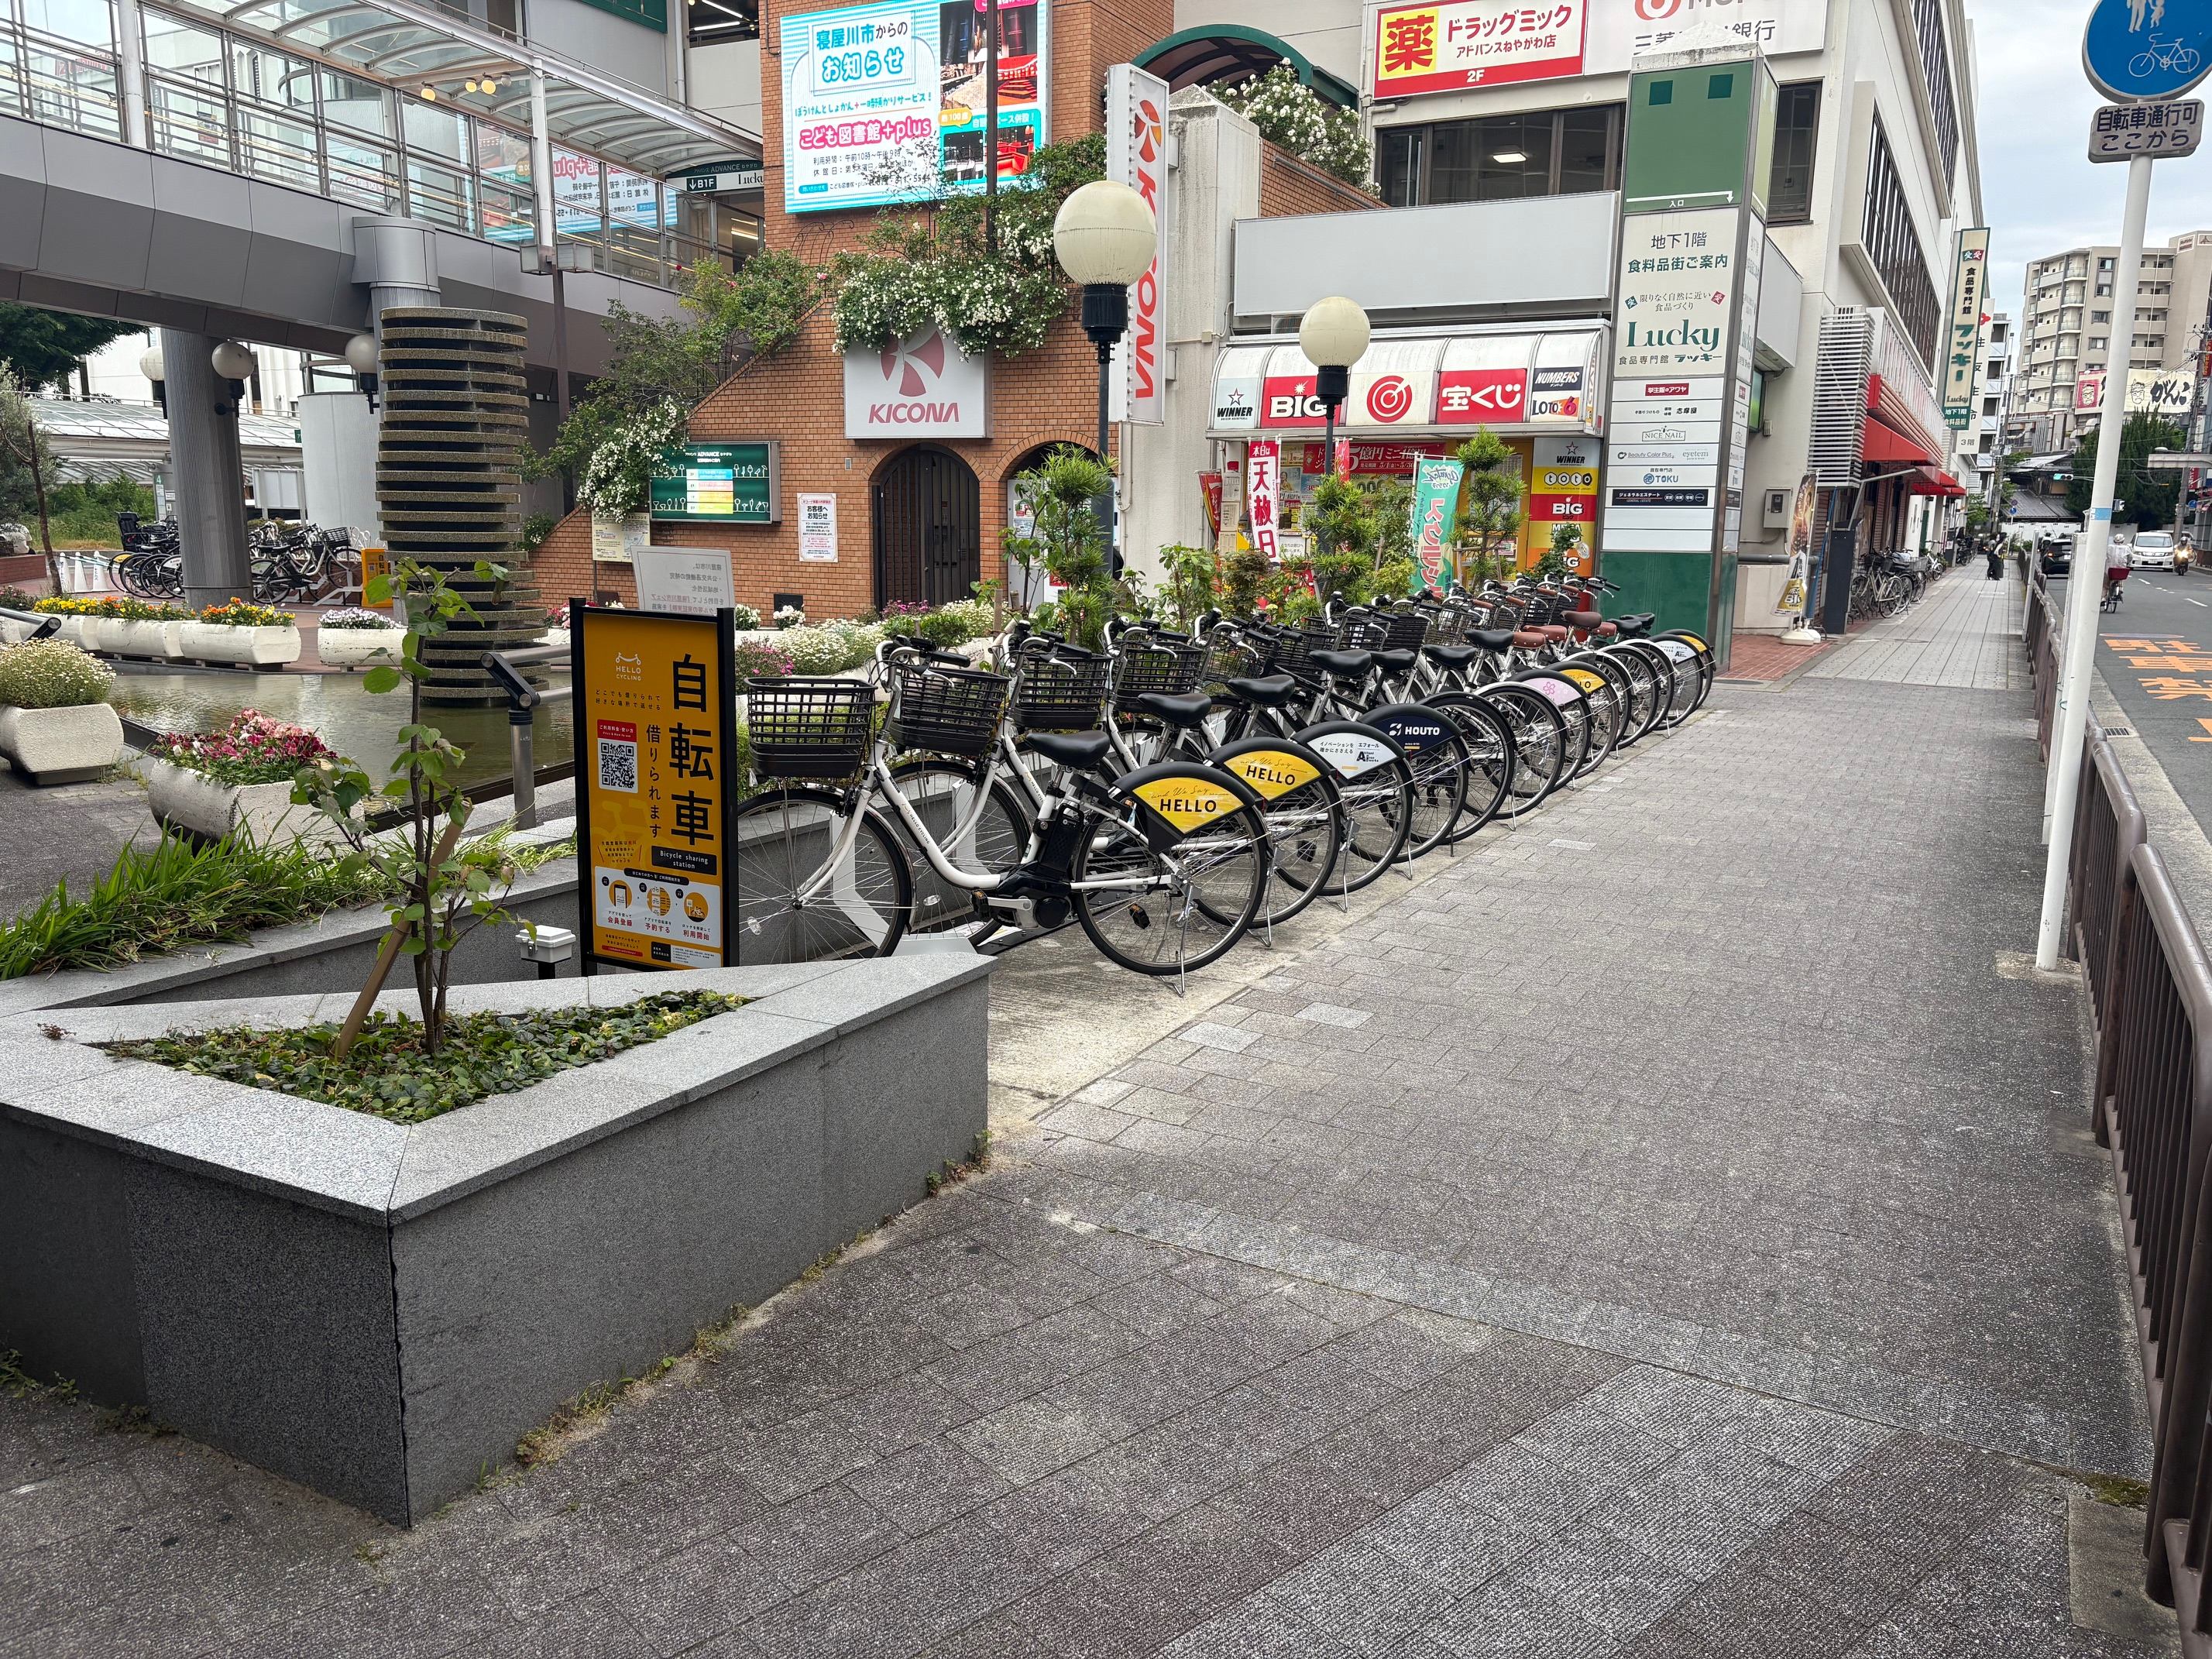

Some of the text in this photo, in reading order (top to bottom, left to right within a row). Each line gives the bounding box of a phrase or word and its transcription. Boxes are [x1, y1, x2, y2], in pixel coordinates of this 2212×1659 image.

[1448, 4, 1572, 43] ドラッグミック
[816, 22, 908, 52] 寝屋川市からの
[1385, 15, 1434, 72] 薬
[1456, 33, 1557, 59] アドバンスねやがわ店
[823, 47, 905, 82] お知らせ
[1466, 69, 1485, 83] 2F
[2097, 102, 2200, 132] 自転車通行可
[2101, 129, 2190, 151] ここから
[711, 163, 740, 173] ADVANCE
[698, 173, 764, 188] B1F Lucky
[1650, 232, 1707, 249] 地下1階
[1627, 254, 1728, 273] 食料品街ご案内
[1136, 167, 1157, 398] KONA
[1640, 291, 1711, 303] 限りなく自然に近い
[1963, 267, 1977, 314] 食品専門館
[1655, 302, 1694, 311] 食品づくり
[1626, 319, 1720, 352] Lucky
[1619, 353, 1723, 365] 食品専門館 ラッキー
[1951, 324, 1974, 381] ラッキー
[1535, 372, 1580, 384] NUMBERS
[1441, 383, 1521, 411] 宝くじ
[2149, 378, 2191, 407] がんこ
[1217, 407, 1253, 417] WINNER
[1269, 393, 1327, 418] BIG
[1532, 396, 1577, 416] LOTO 6
[868, 403, 960, 424] KICONA
[1252, 445, 1271, 456] 本日は
[1556, 455, 1585, 464] WINNER
[156, 475, 162, 483] 4
[1544, 472, 1592, 486] toto
[1552, 503, 1583, 514] BIG
[1552, 523, 1582, 532] MEA
[596, 689, 661, 701] どこでも借りられて
[596, 698, 661, 710] 好きな場所で返せる
[1405, 726, 1440, 736] HOUTO
[668, 654, 714, 846] 自転車
[1259, 757, 1273, 767] We
[1274, 758, 1293, 770] Say
[646, 724, 661, 837] 借りられます
[1245, 765, 1296, 786] HELLO
[1151, 785, 1211, 799] and We Say
[1159, 799, 1217, 812] HELLO
[909, 814, 930, 843] HELLO CYCLING
[660, 850, 709, 865] Bicycle sharing
[607, 916, 633, 926] 会員登録
[644, 923, 670, 933] 予約する
[682, 929, 709, 941] 利用開始
